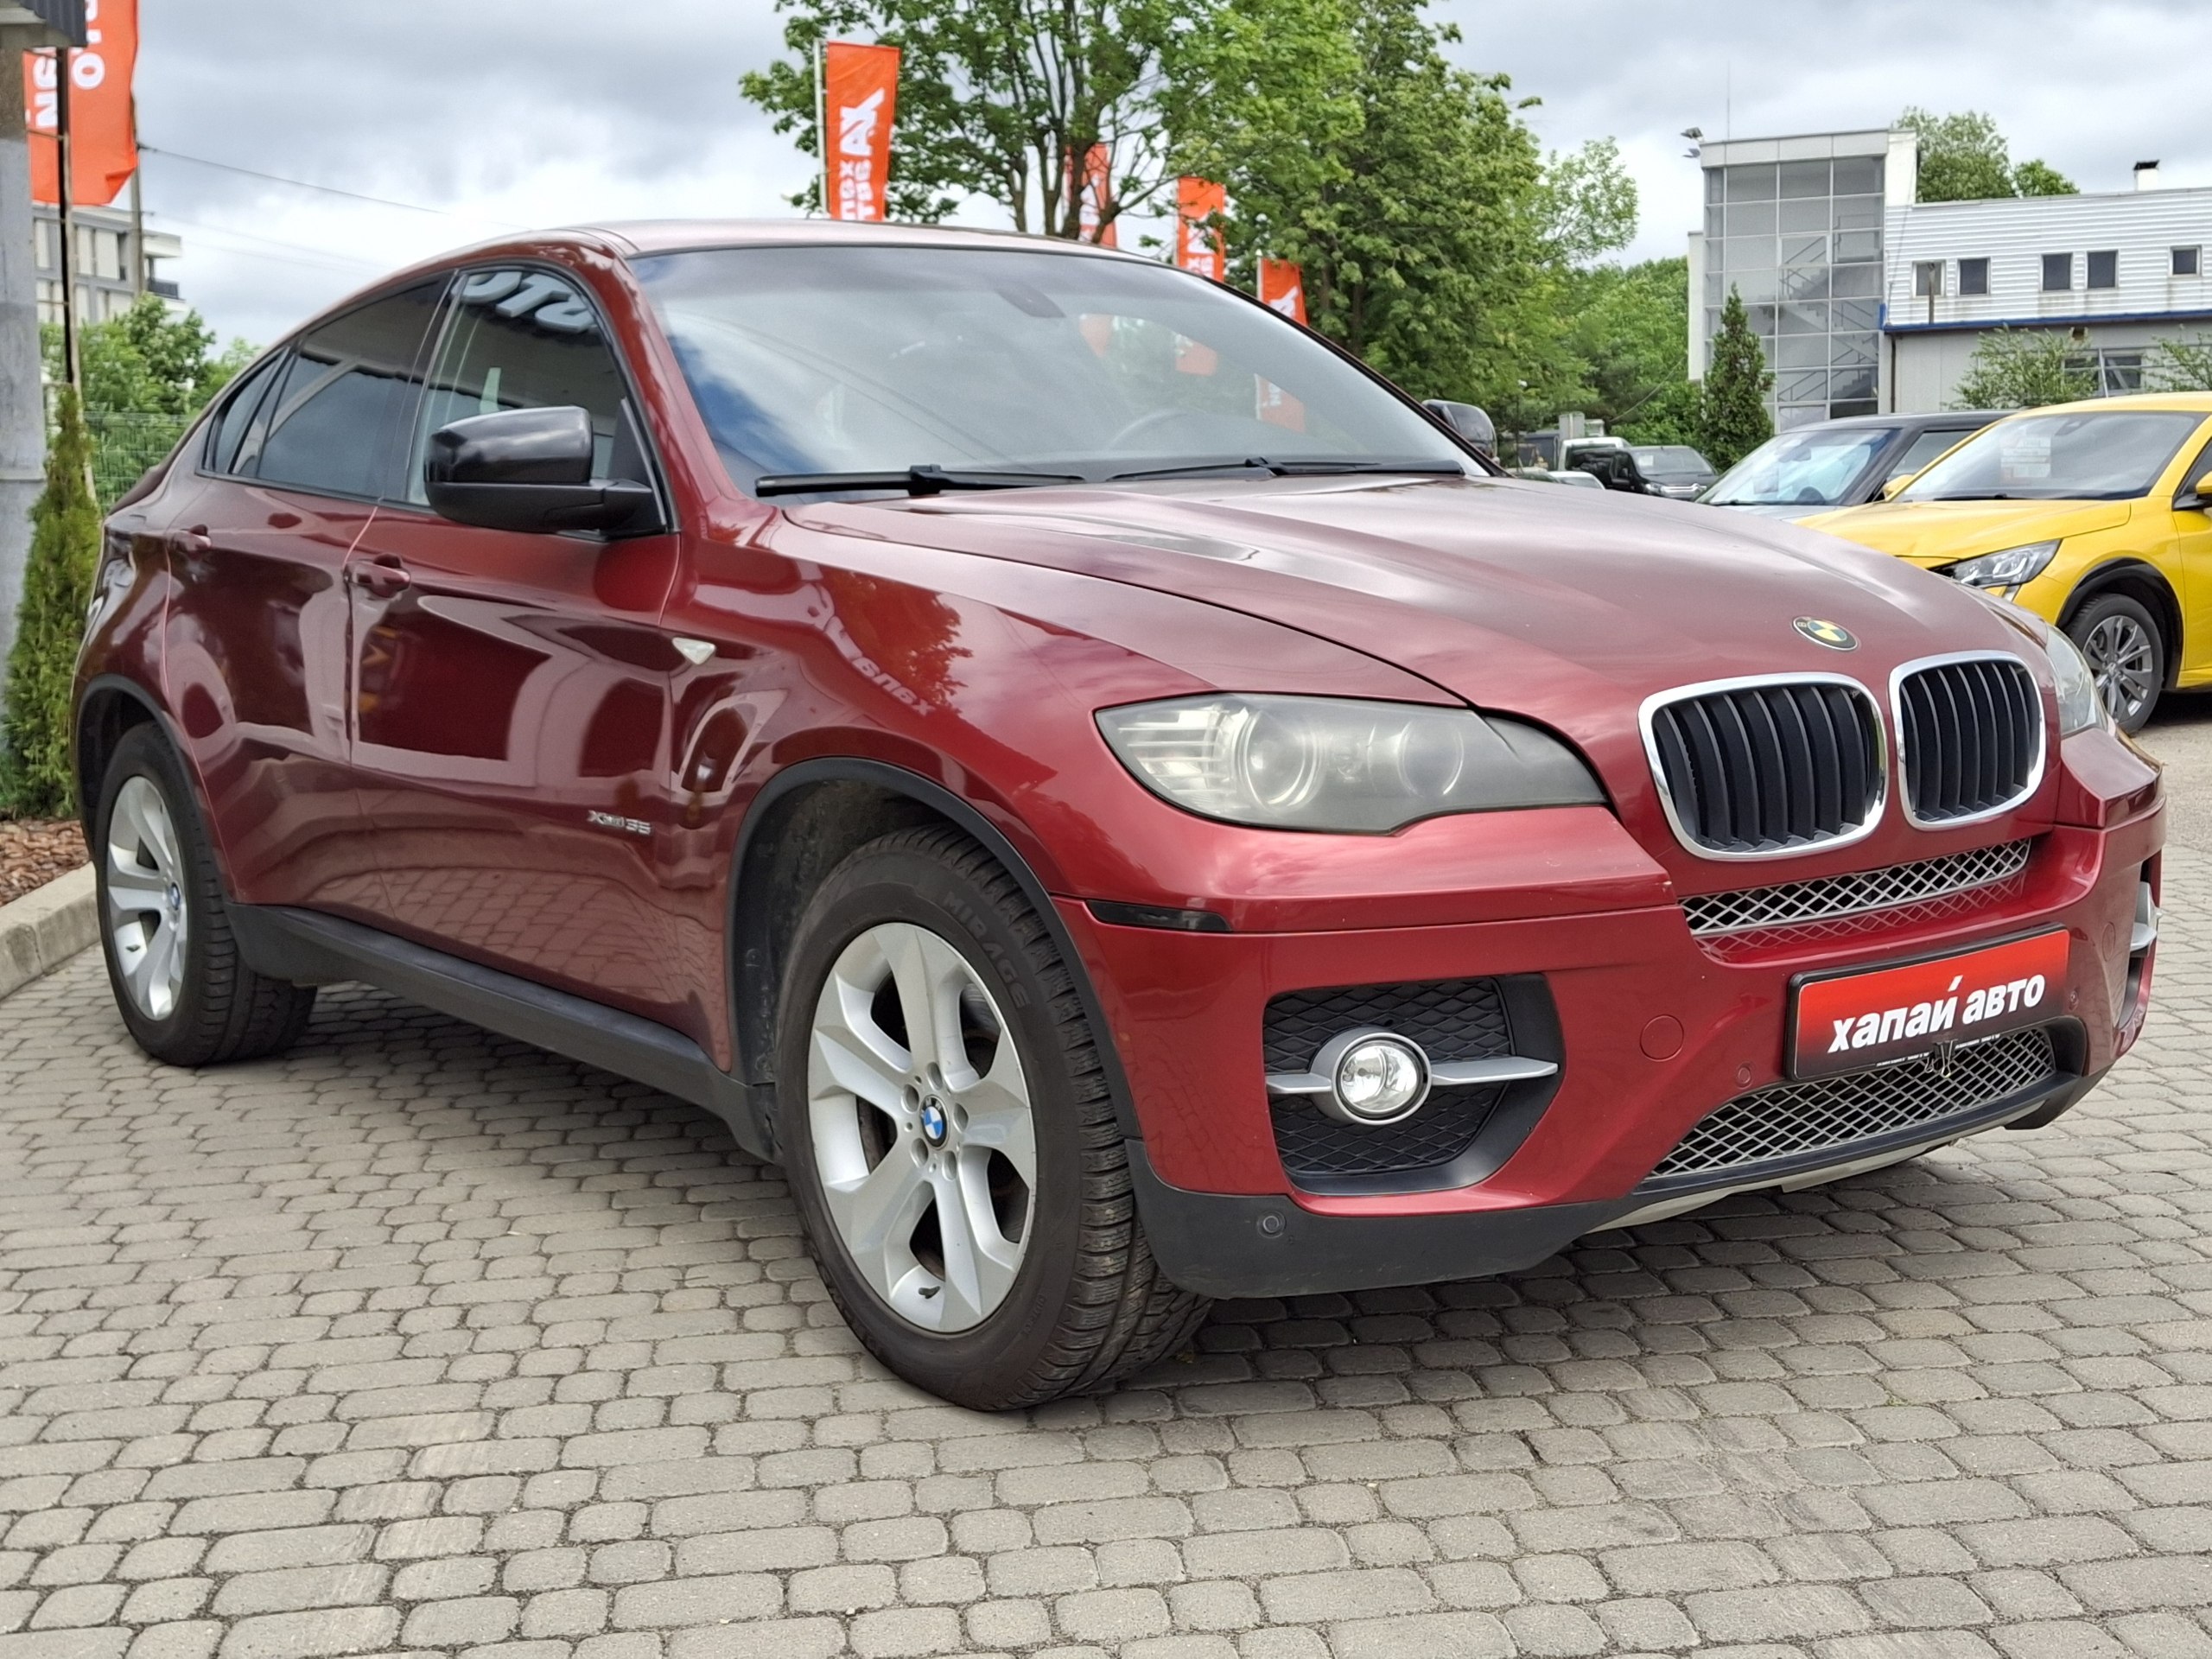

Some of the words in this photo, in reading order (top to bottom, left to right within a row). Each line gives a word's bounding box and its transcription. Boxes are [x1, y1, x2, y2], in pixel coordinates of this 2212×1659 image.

[943, 891, 1032, 1008] MIRAGE
[1827, 975, 1963, 1053] хапай
[1962, 974, 2045, 1024] авто
